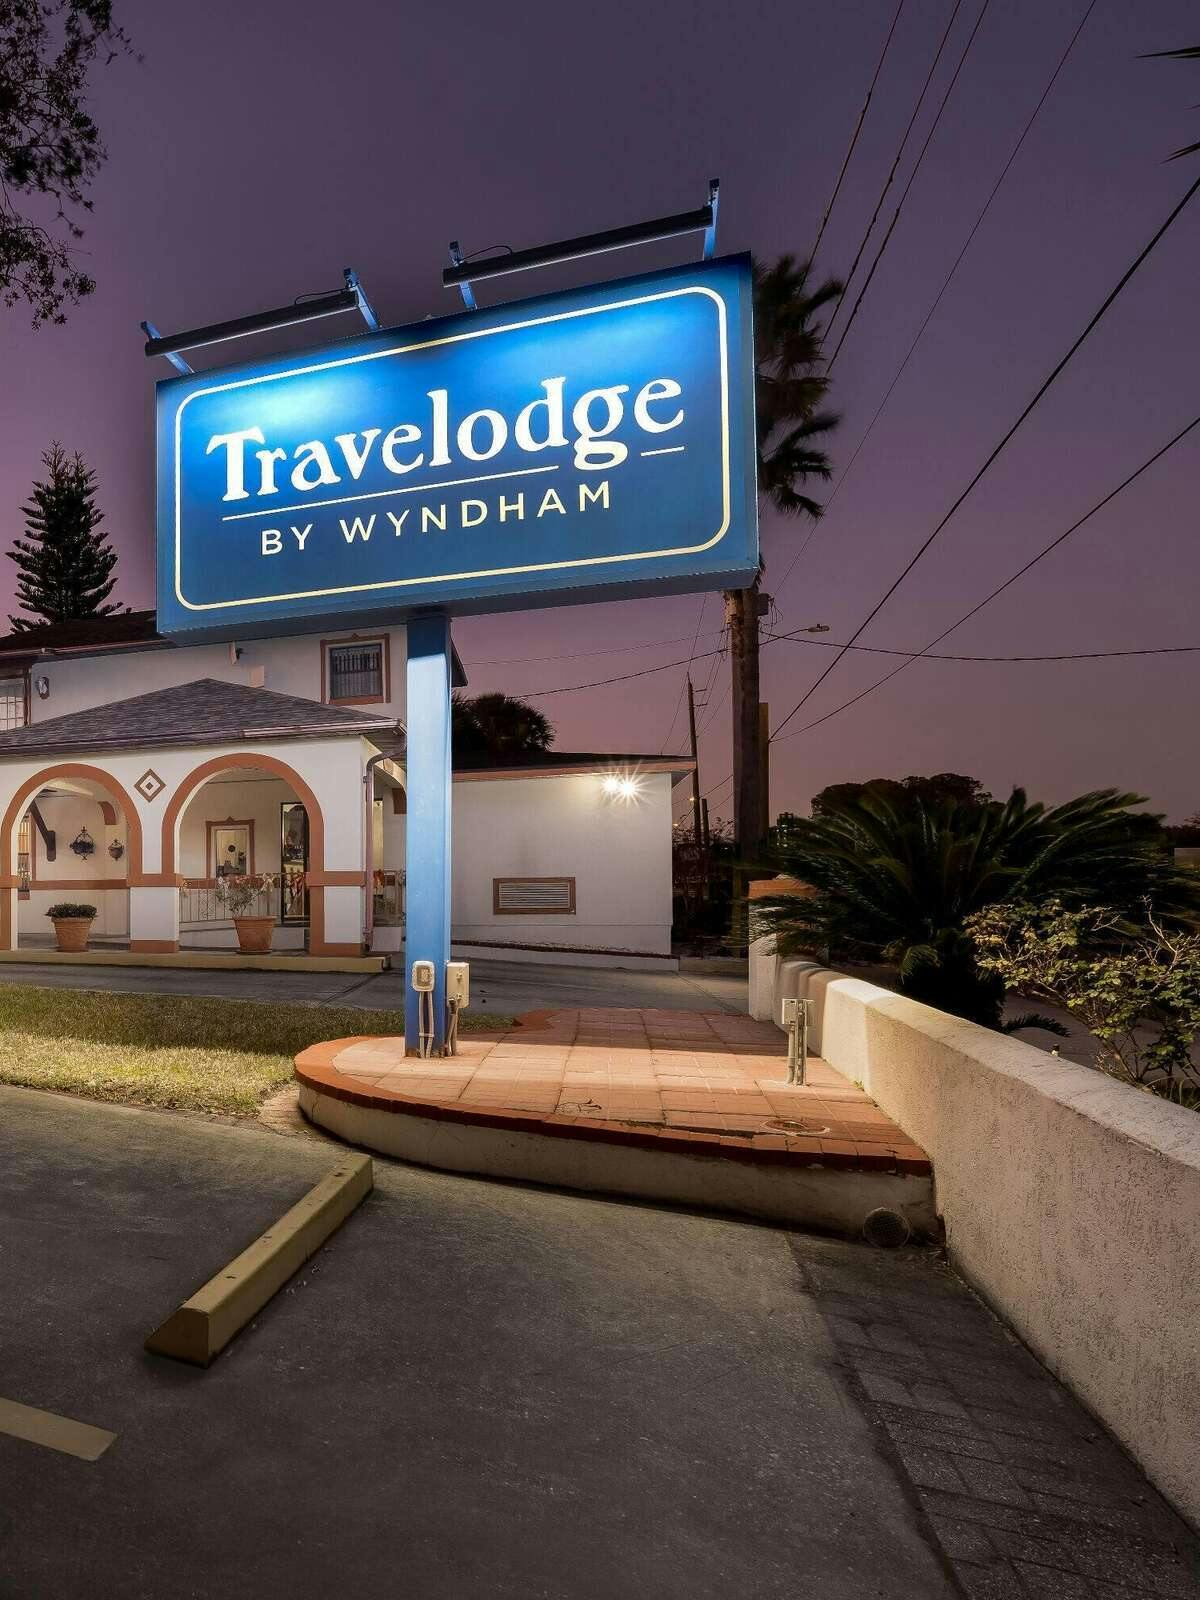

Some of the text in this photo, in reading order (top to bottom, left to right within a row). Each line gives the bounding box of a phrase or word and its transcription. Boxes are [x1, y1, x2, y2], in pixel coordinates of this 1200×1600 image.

[206, 377, 684, 502] Travelodge
[261, 481, 611, 555] BY WYNDHAM
